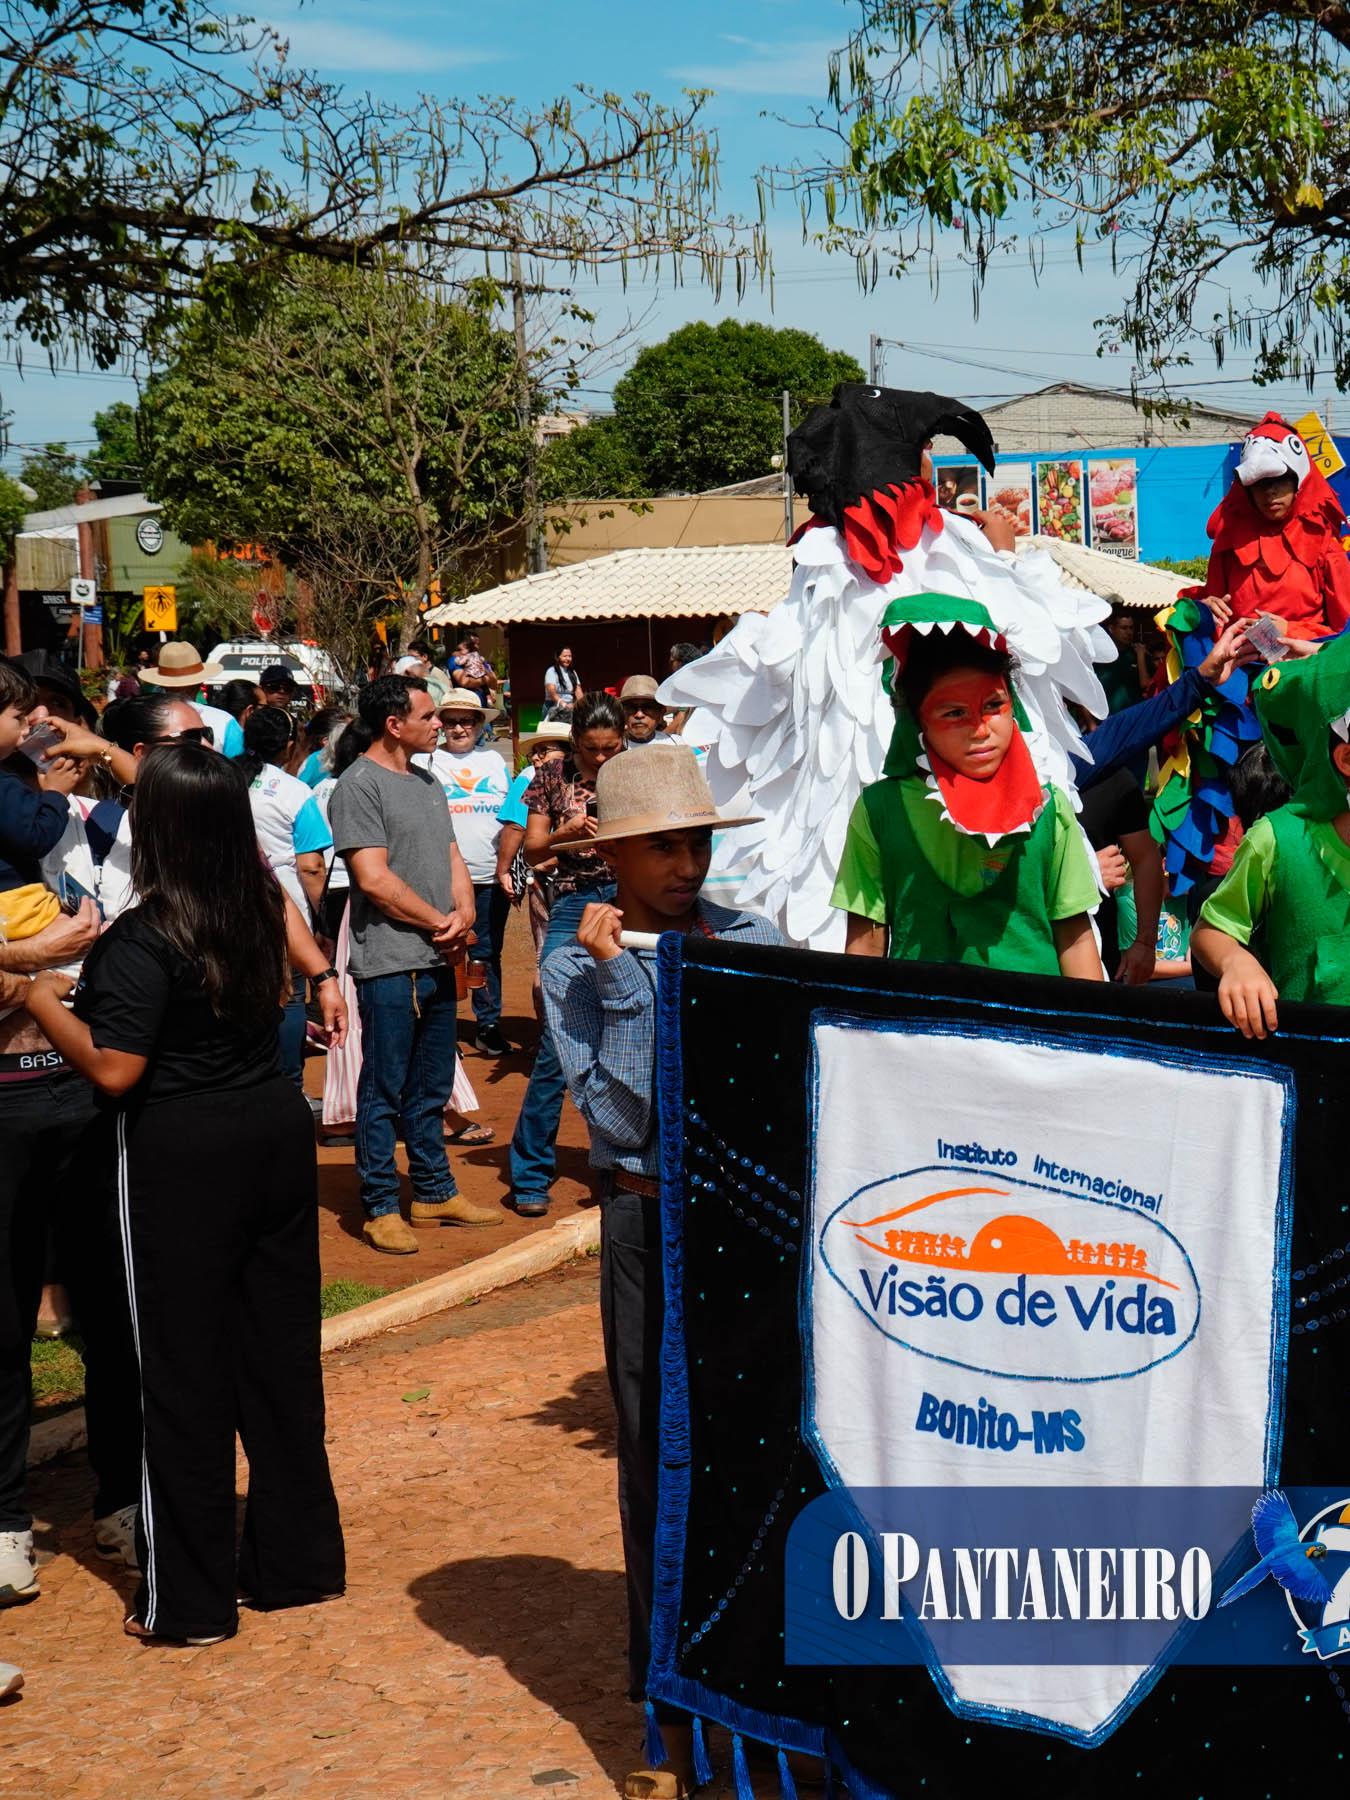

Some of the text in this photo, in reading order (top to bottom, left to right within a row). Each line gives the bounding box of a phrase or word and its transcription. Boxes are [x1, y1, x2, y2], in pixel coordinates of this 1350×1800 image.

[240, 655, 282, 666] POLÍCIA
[937, 1138, 1164, 1215] Instituto Internacional
[859, 1264, 1177, 1336] Visão de Vida
[915, 1391, 1086, 1455] Bonito-MS
